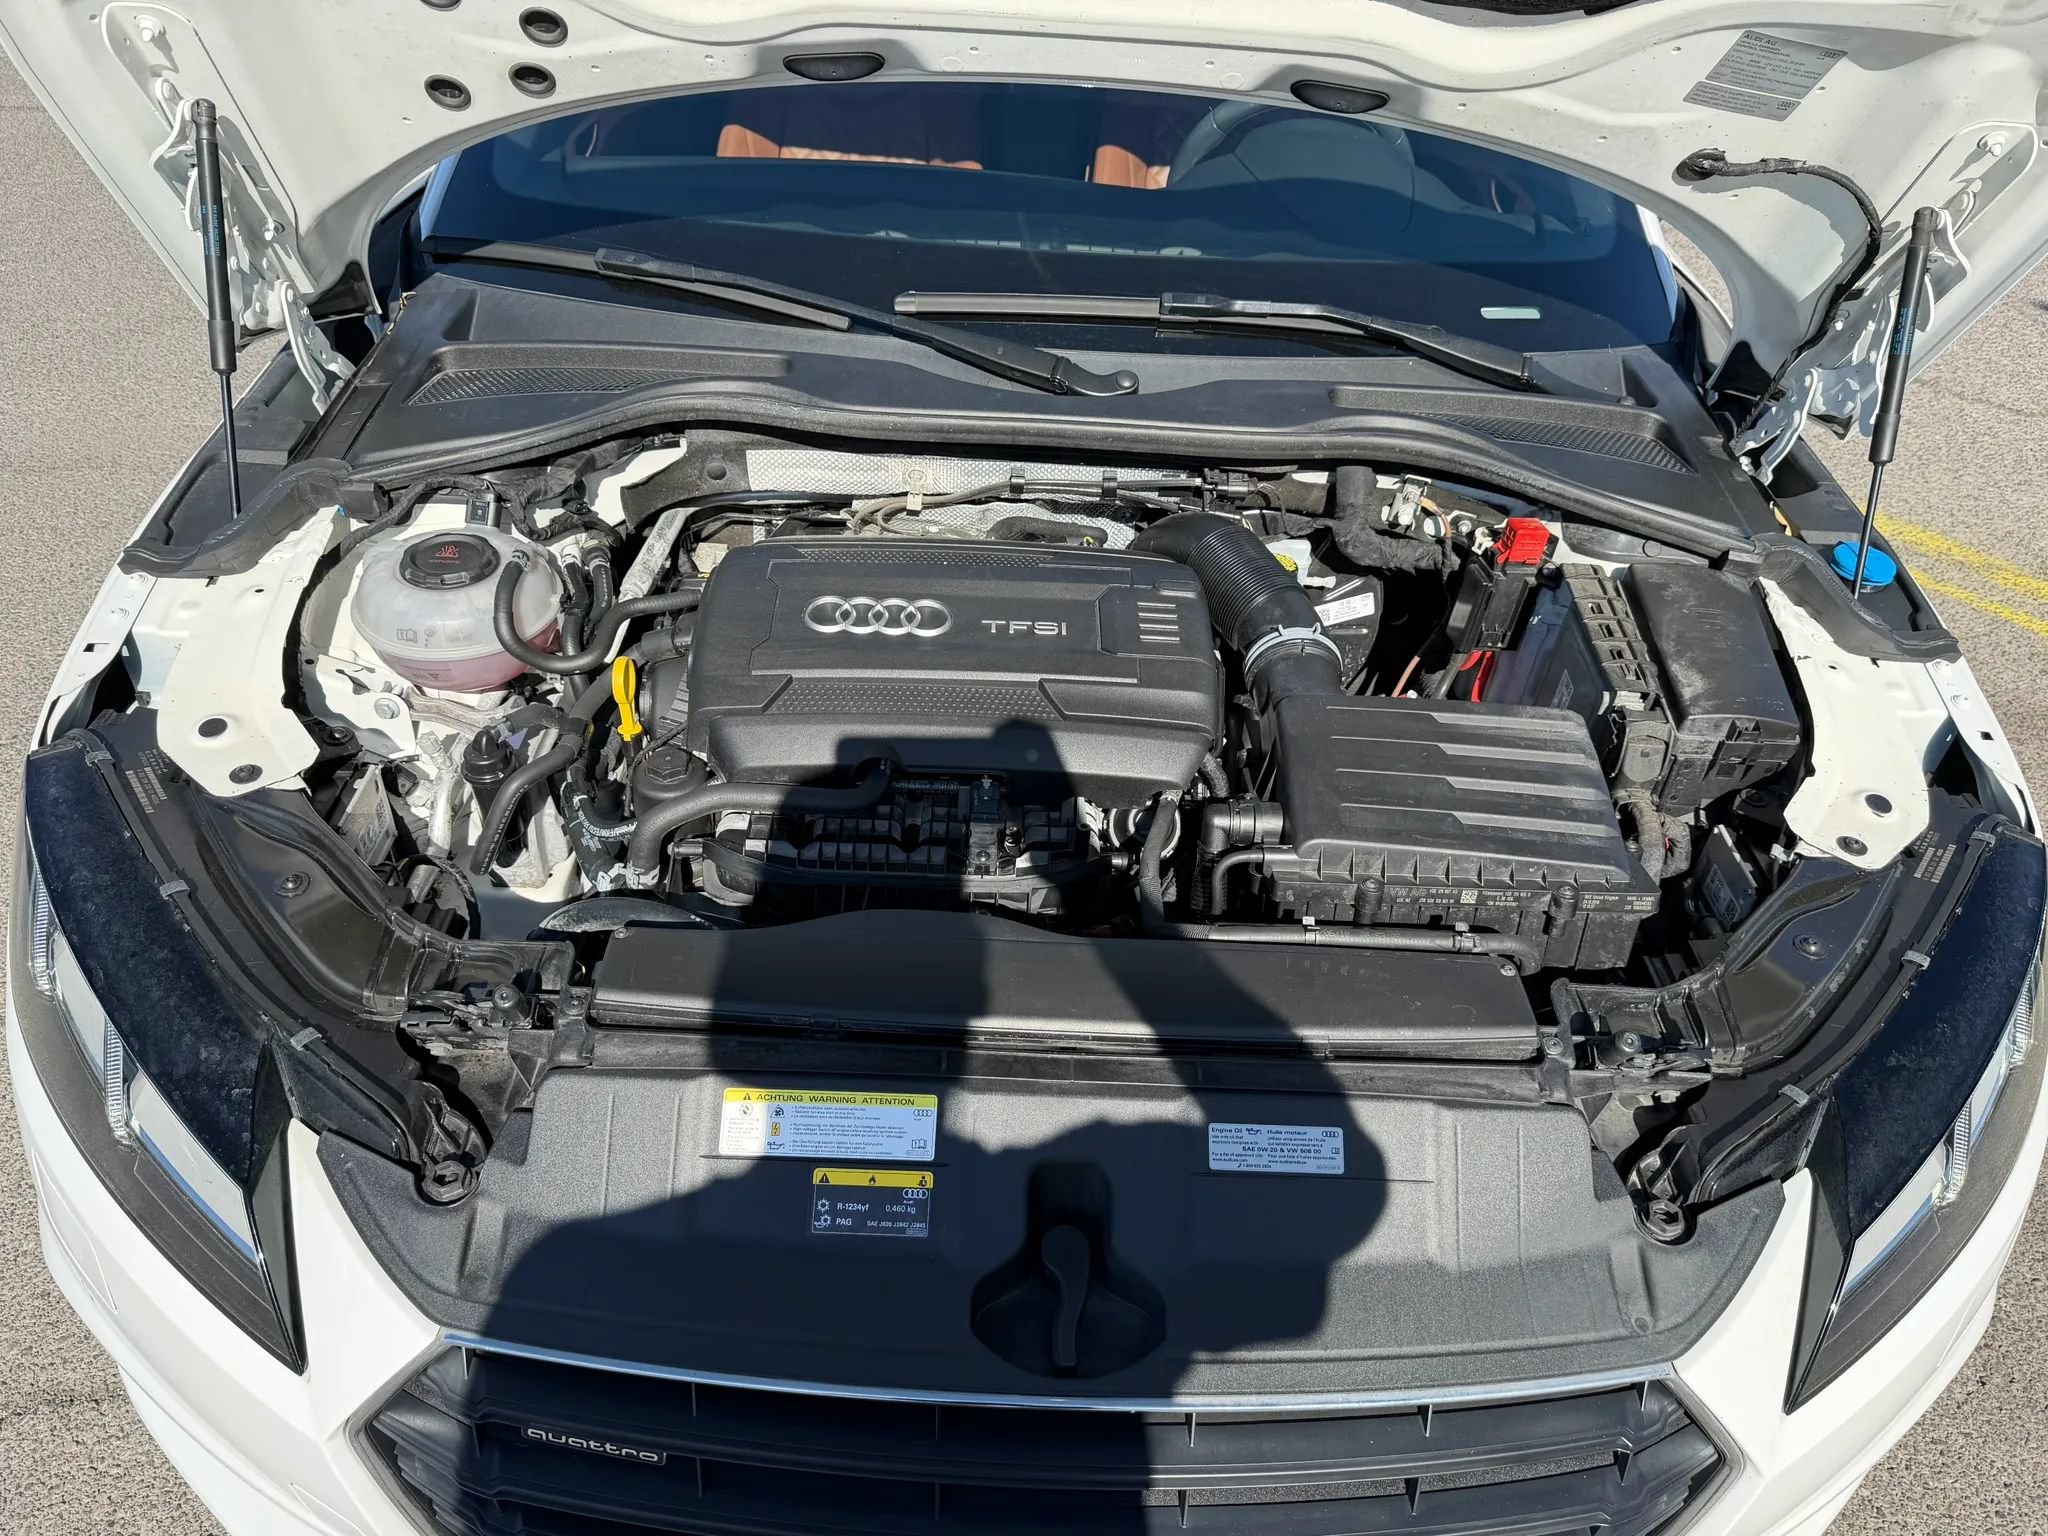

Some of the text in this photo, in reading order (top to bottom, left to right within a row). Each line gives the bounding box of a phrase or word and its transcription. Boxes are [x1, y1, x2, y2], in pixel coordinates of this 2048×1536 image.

[1743, 34, 1763, 43] AUDI
[981, 620, 1067, 636] TFSI
[1390, 888, 1409, 896] VW
[1410, 888, 1428, 896] AG
[756, 1094, 915, 1106] ACHTUNG WARNING ATTENTION
[1212, 1127, 1232, 1135] Engine
[837, 1202, 869, 1212] R-1234yf
[907, 1205, 916, 1214] kg
[836, 1218, 852, 1226] PAG
[528, 1428, 658, 1462] quattro
